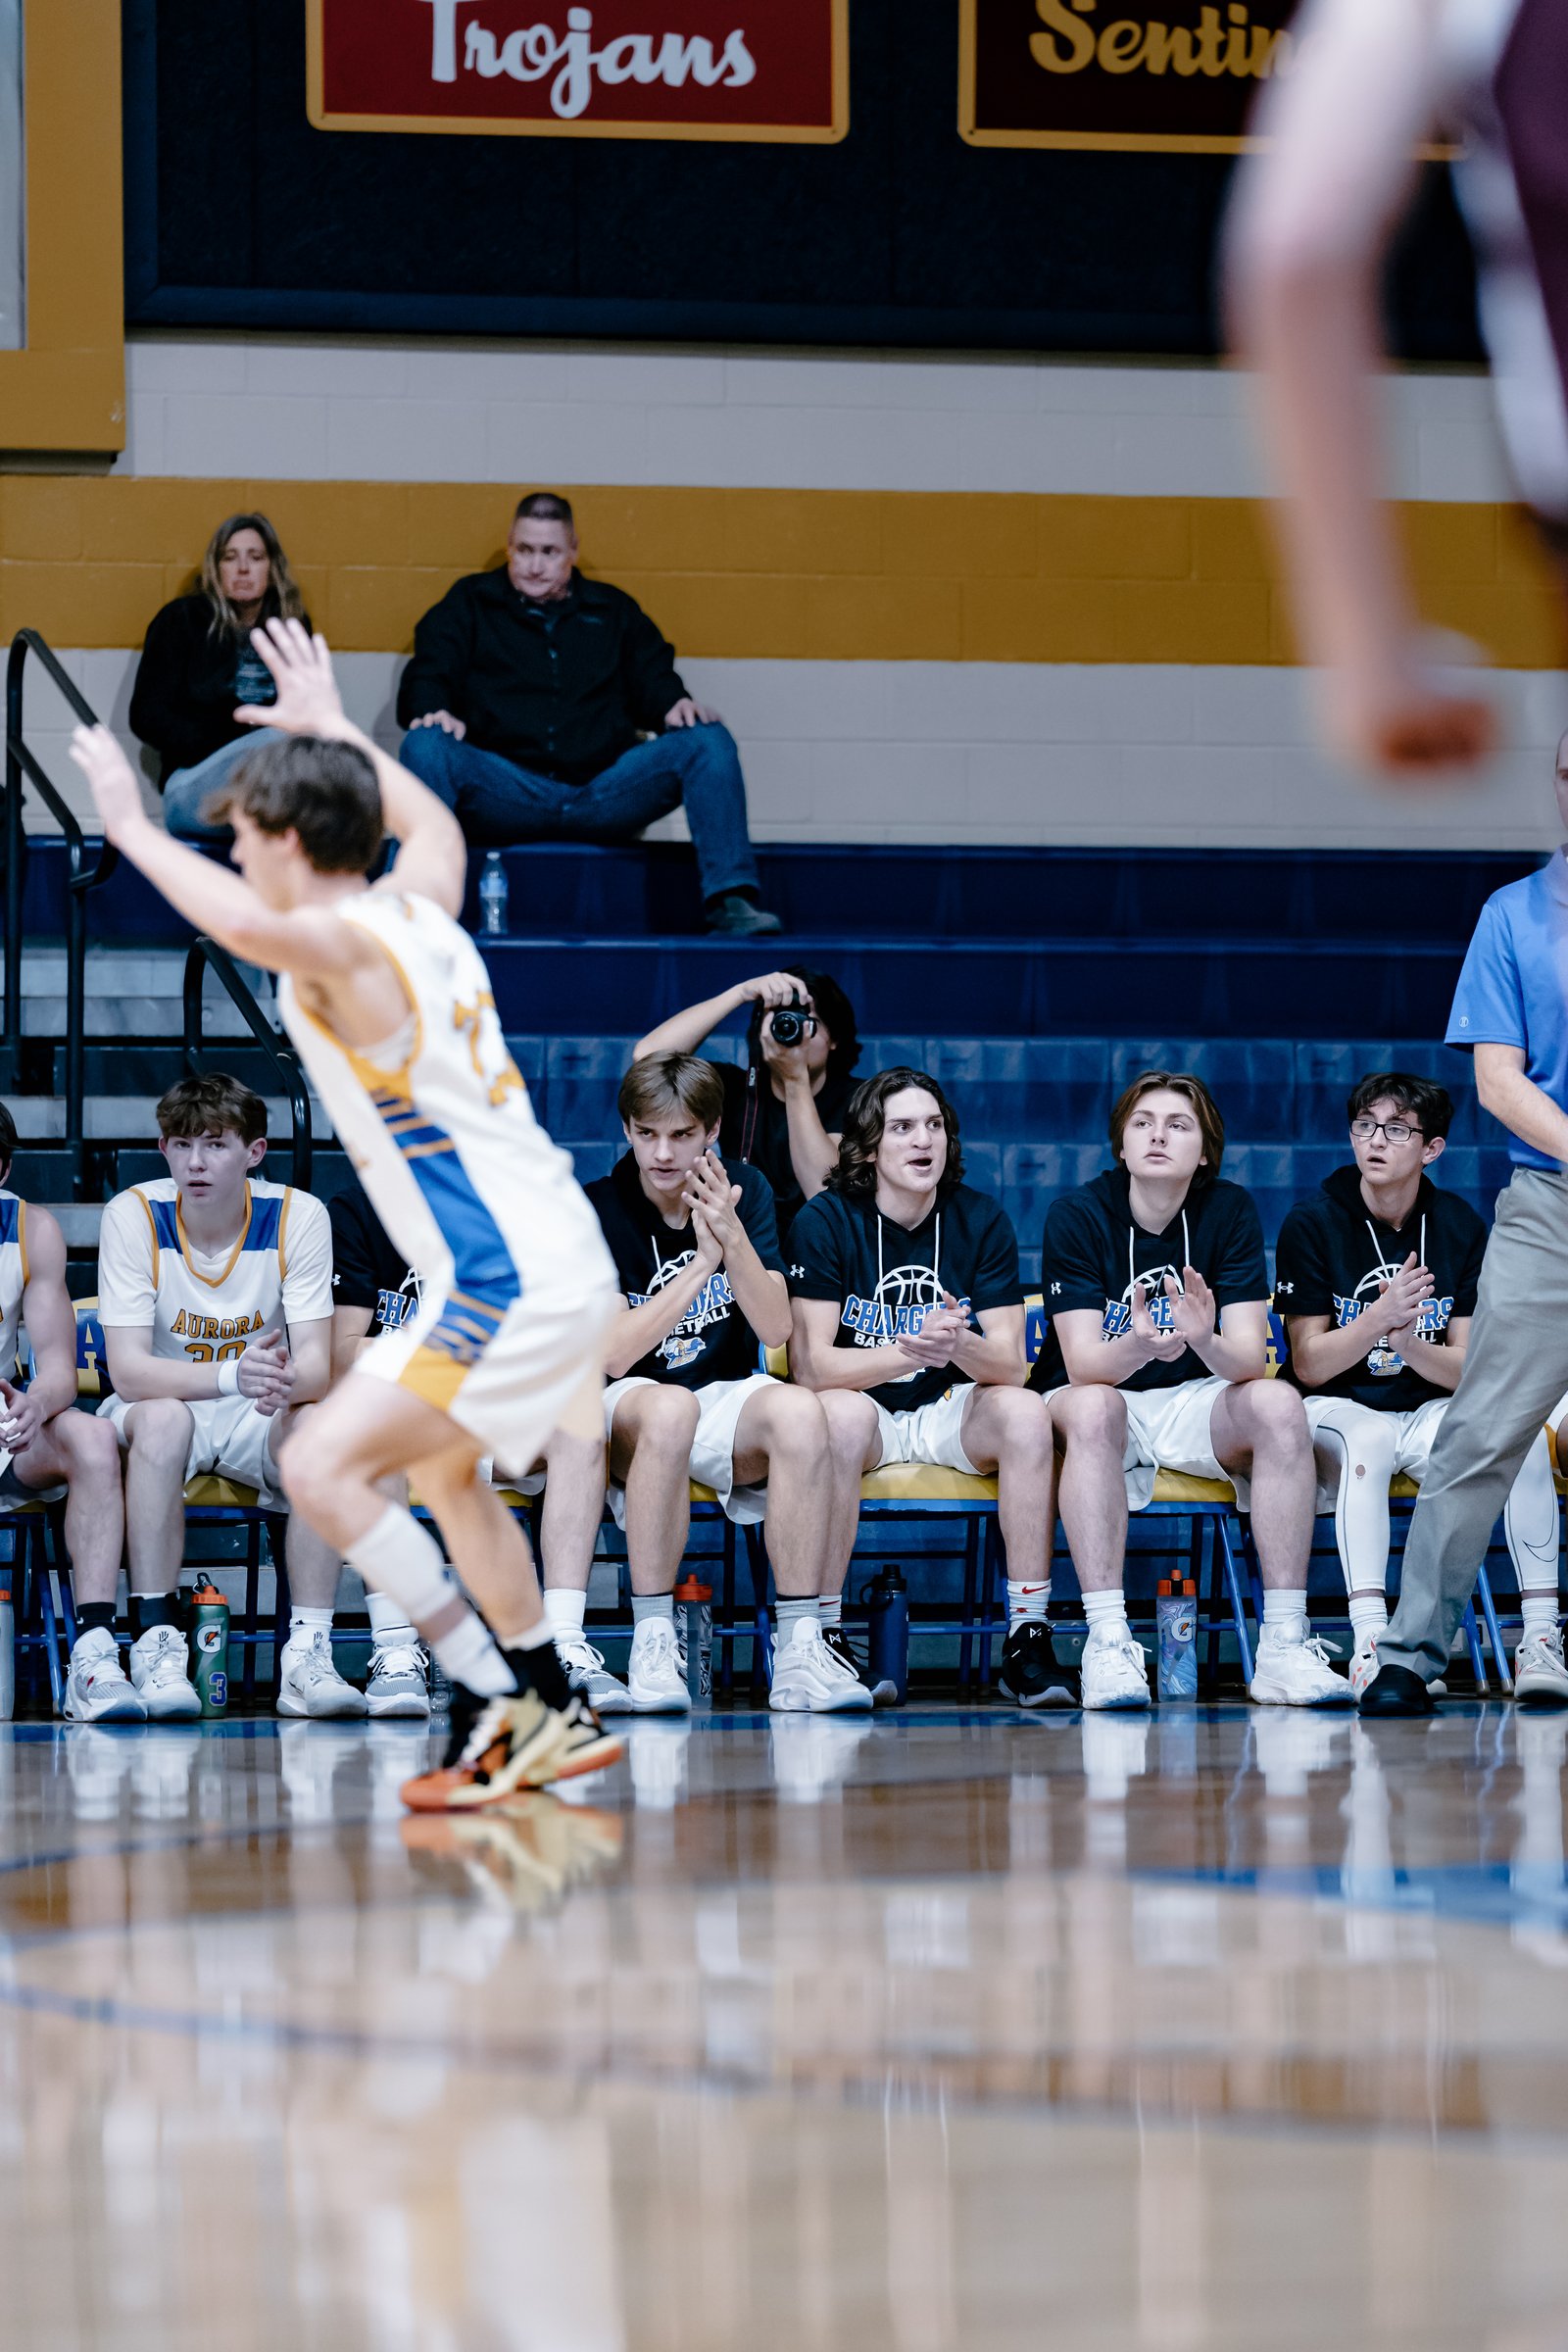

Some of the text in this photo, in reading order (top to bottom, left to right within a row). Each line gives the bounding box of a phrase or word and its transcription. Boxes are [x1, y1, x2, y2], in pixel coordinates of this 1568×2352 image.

[421, 0, 757, 119] Trojans
[1029, 0, 1296, 78] Sentin
[170, 1308, 265, 1339] AURORA
[209, 1672, 226, 1706] 3
